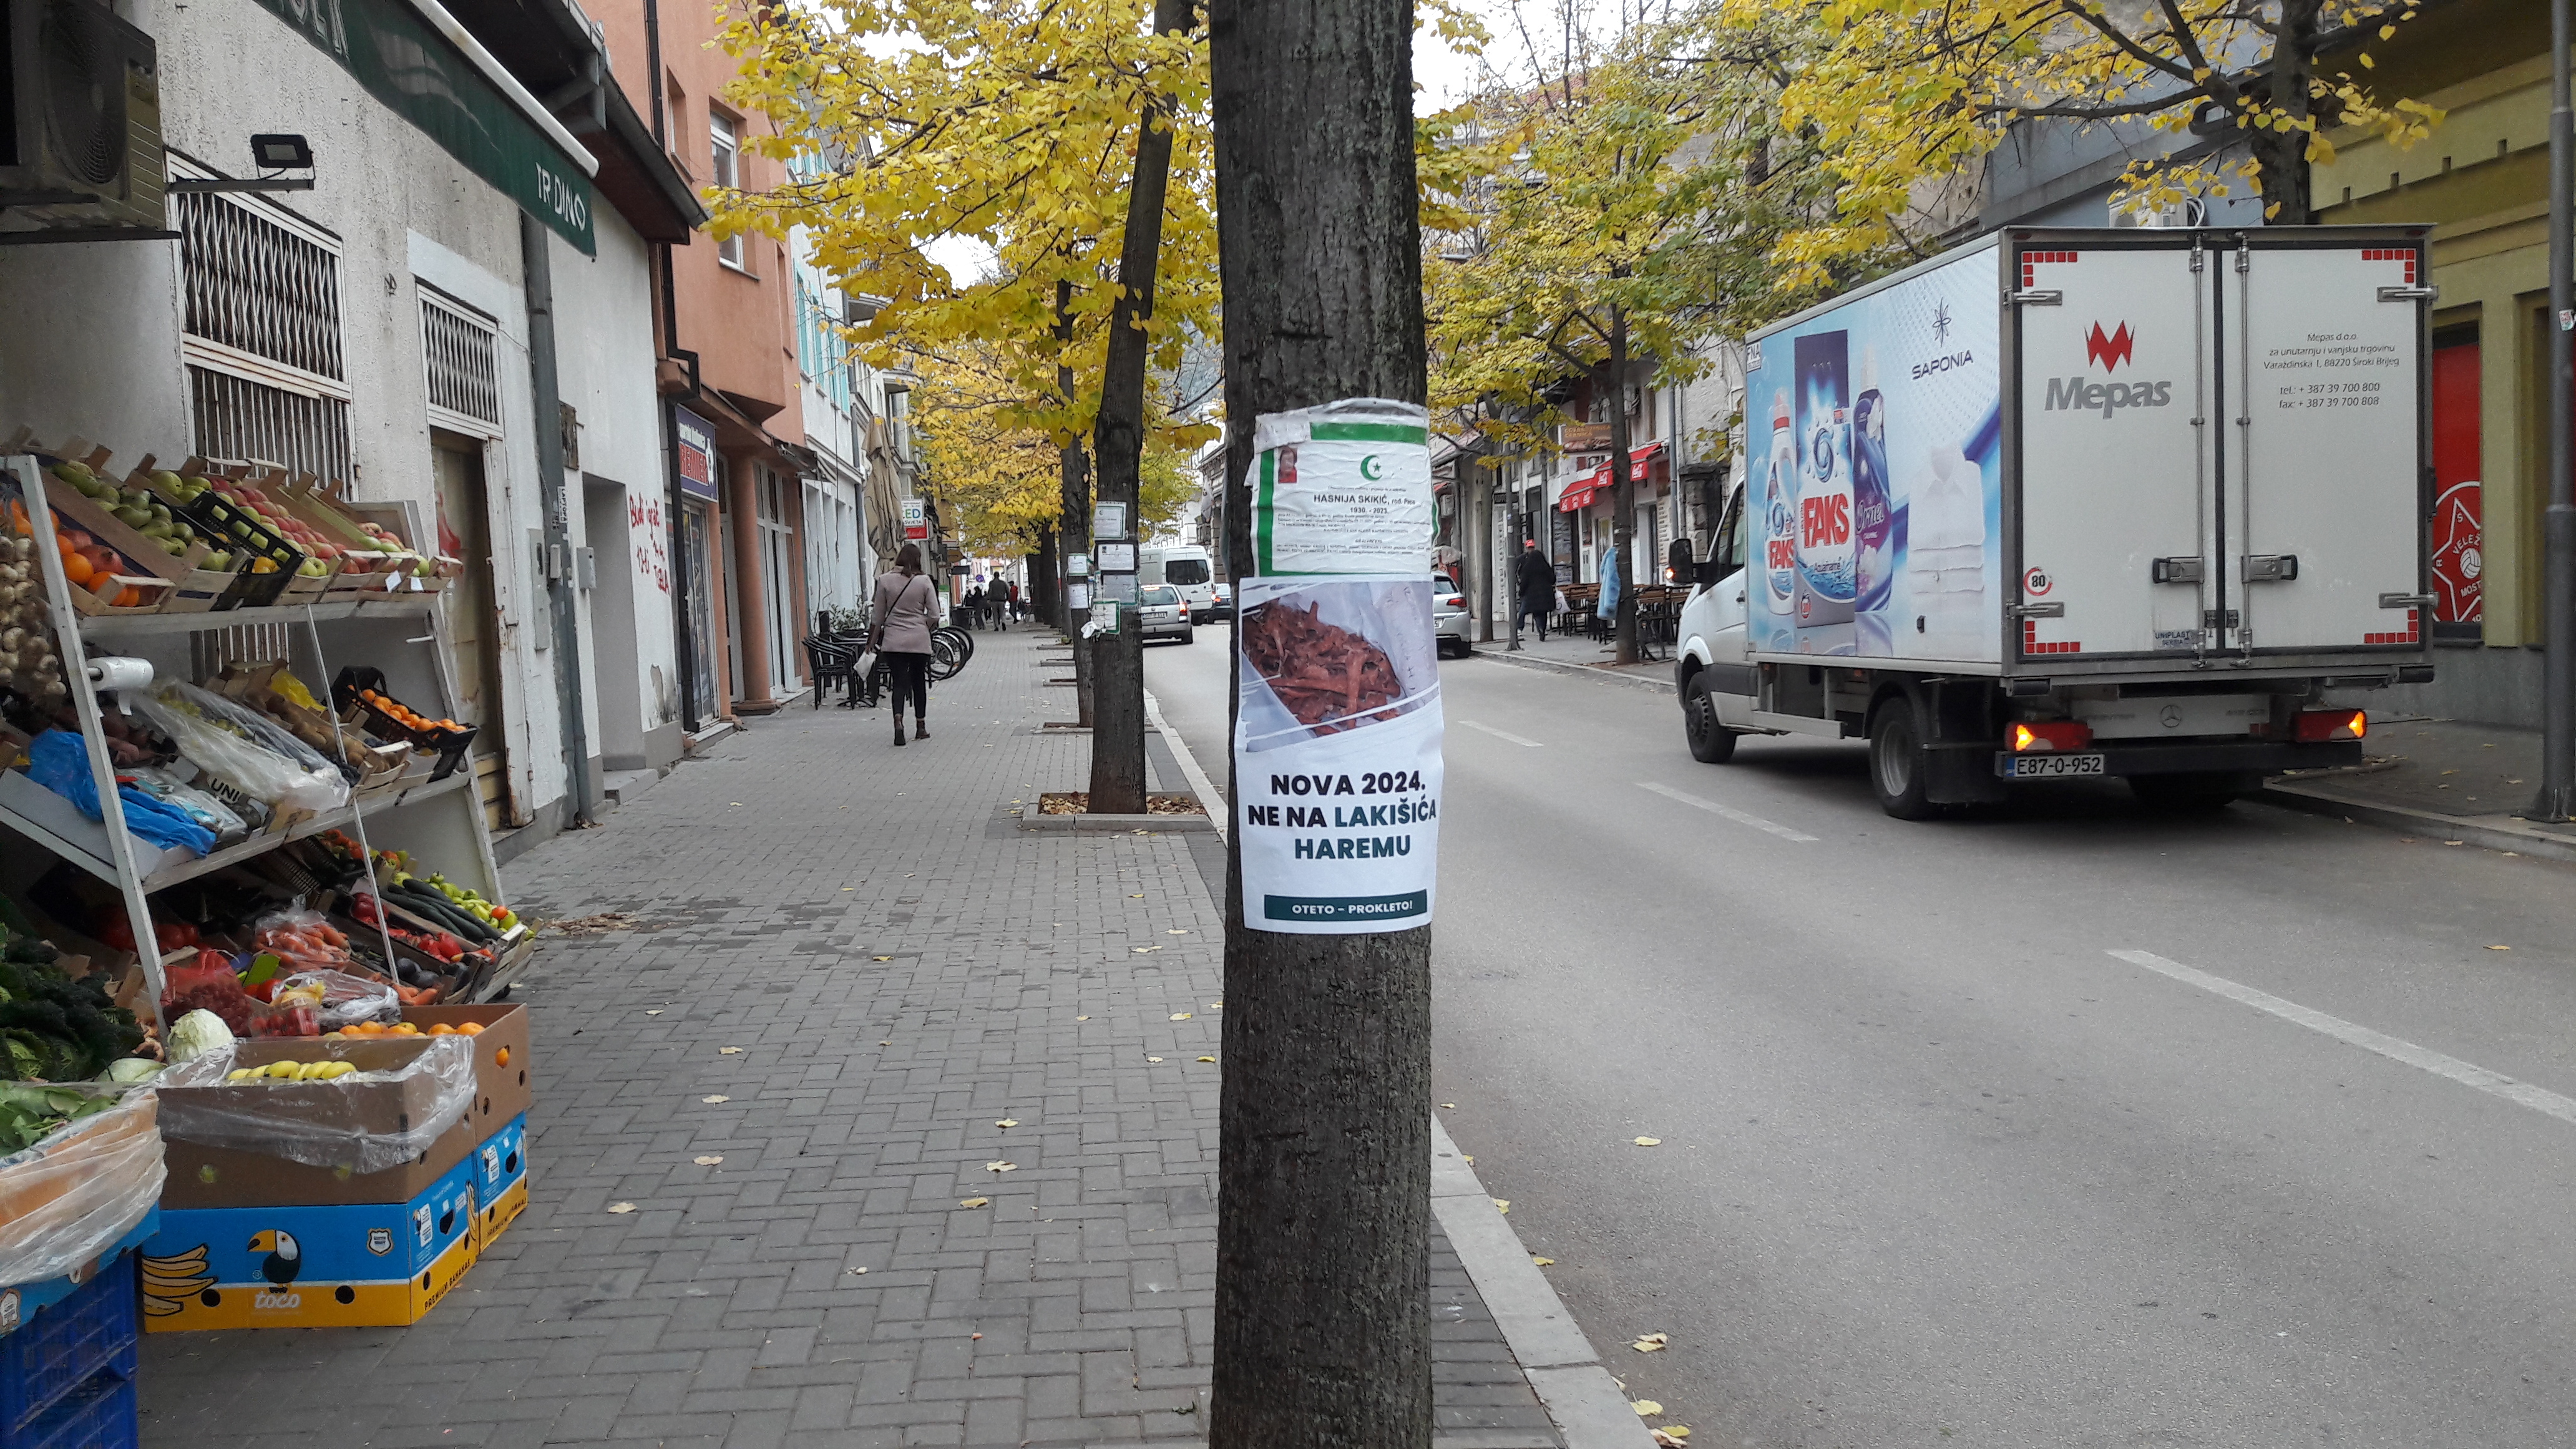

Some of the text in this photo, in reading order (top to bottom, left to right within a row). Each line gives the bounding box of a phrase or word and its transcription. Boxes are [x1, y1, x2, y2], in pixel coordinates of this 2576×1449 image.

[536, 162, 586, 232] TR DINO
[2307, 333, 2334, 343] Mepas
[2281, 348, 2321, 356] unutarnju
[2328, 345, 2358, 356] vanjsku
[2360, 344, 2396, 355] trgovinu
[1911, 350, 1974, 380] SAPONIA
[2263, 360, 2313, 369] Varaždinska
[2324, 358, 2351, 367] 88220
[2353, 356, 2374, 366] Široki
[2376, 357, 2399, 368] Brijeg
[2308, 384, 2325, 394] 387
[2327, 384, 2339, 393] 39
[2342, 383, 2359, 393] 700
[2362, 382, 2380, 391] 800
[2044, 376, 2171, 419] Mepas
[2306, 398, 2325, 408] 387
[2326, 398, 2339, 406] 39
[2341, 397, 2359, 406] 700
[2361, 396, 2380, 405] 808
[1314, 494, 1355, 503] HASNIJA
[1358, 494, 1390, 505] SKIKIĆ,
[1803, 493, 1850, 549] FAKS
[2032, 575, 2046, 587] 80
[212, 778, 240, 802] UNI
[1271, 770, 1426, 796] NOVA 2024.
[1248, 794, 1437, 827] NE NA LAKIŠIĆA
[1295, 834, 1410, 859] HAREMU
[1292, 904, 1335, 915] OTETO
[1348, 900, 1413, 914] PROKLETO!
[255, 1292, 301, 1309] toco
